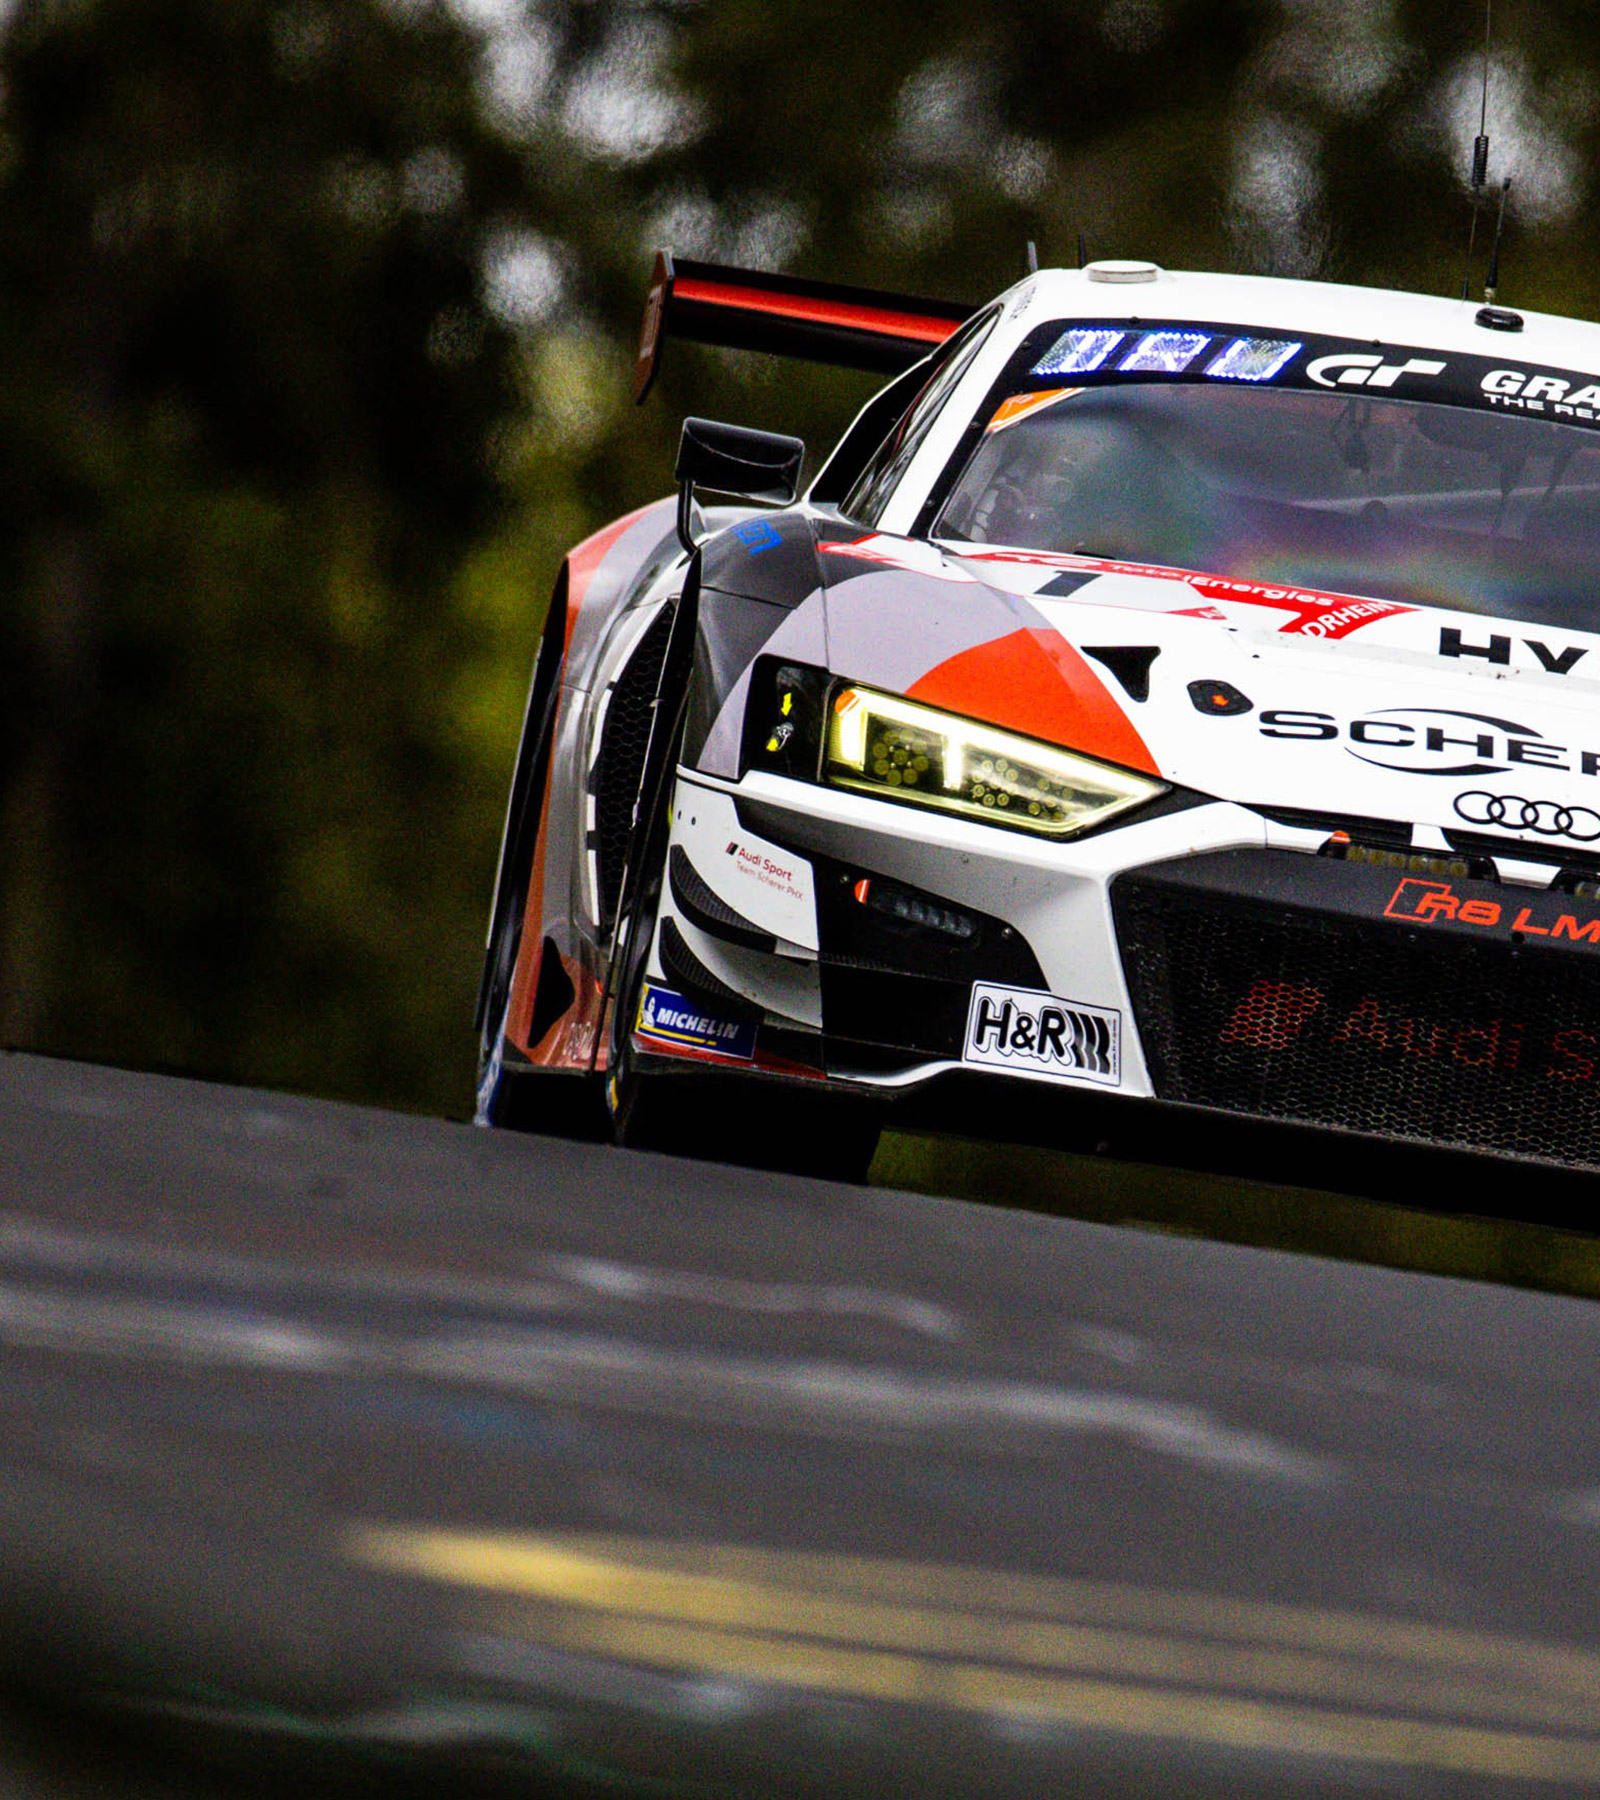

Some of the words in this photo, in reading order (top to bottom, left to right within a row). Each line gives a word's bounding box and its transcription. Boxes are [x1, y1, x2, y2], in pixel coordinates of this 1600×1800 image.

[1483, 393, 1546, 411] THE
[1033, 570, 1103, 597] 1
[736, 860, 755, 877] Team
[738, 847, 761, 866] Audi
[763, 858, 792, 882] Sport
[1413, 891, 1502, 926] R8
[656, 1007, 739, 1040] MICHELIN
[974, 997, 1073, 1066] H&R
[1329, 997, 1524, 1070] Audi
